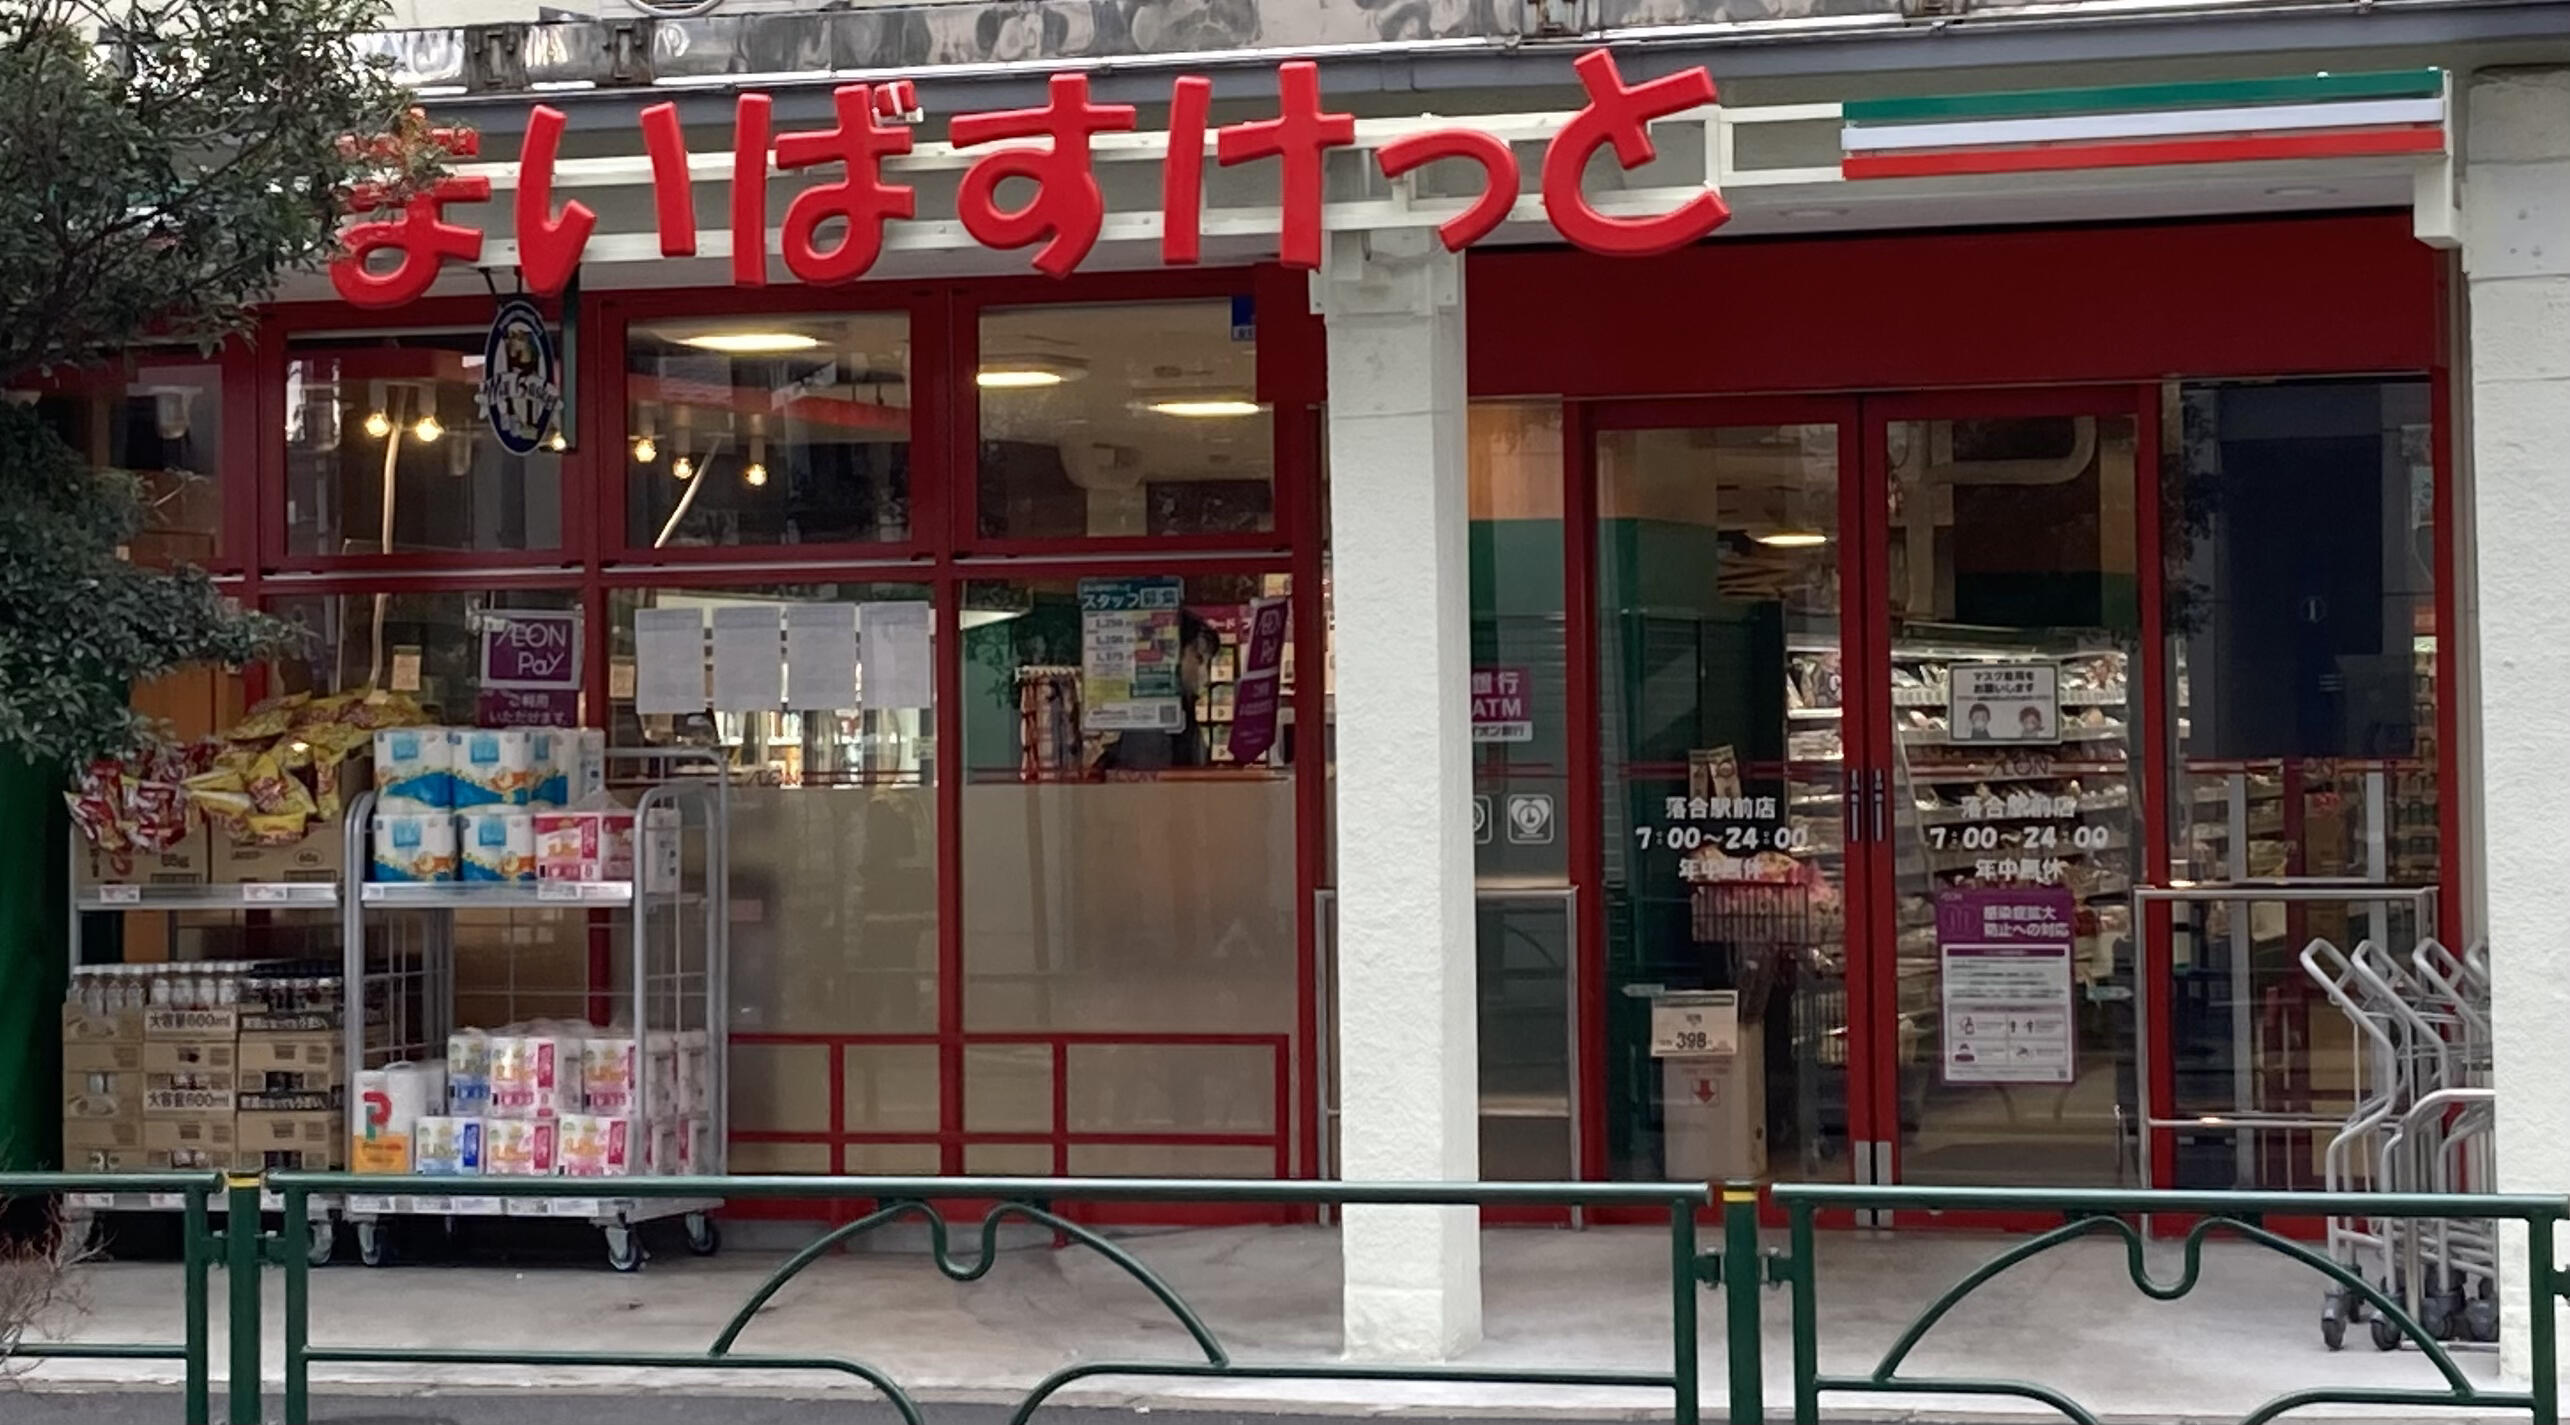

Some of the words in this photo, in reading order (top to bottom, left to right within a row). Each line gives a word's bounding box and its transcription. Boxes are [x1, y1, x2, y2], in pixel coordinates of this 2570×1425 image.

[330, 48, 1732, 307] まいばすけっと
[495, 622, 567, 648] AEON
[517, 651, 565, 676] Pay
[1472, 698, 1522, 718] ATM
[1664, 795, 1777, 820] 落合駅前店
[1983, 904, 2057, 921] 感染症拡大
[1983, 922, 2071, 938] 防止への対応
[1675, 1031, 1707, 1050] 398
